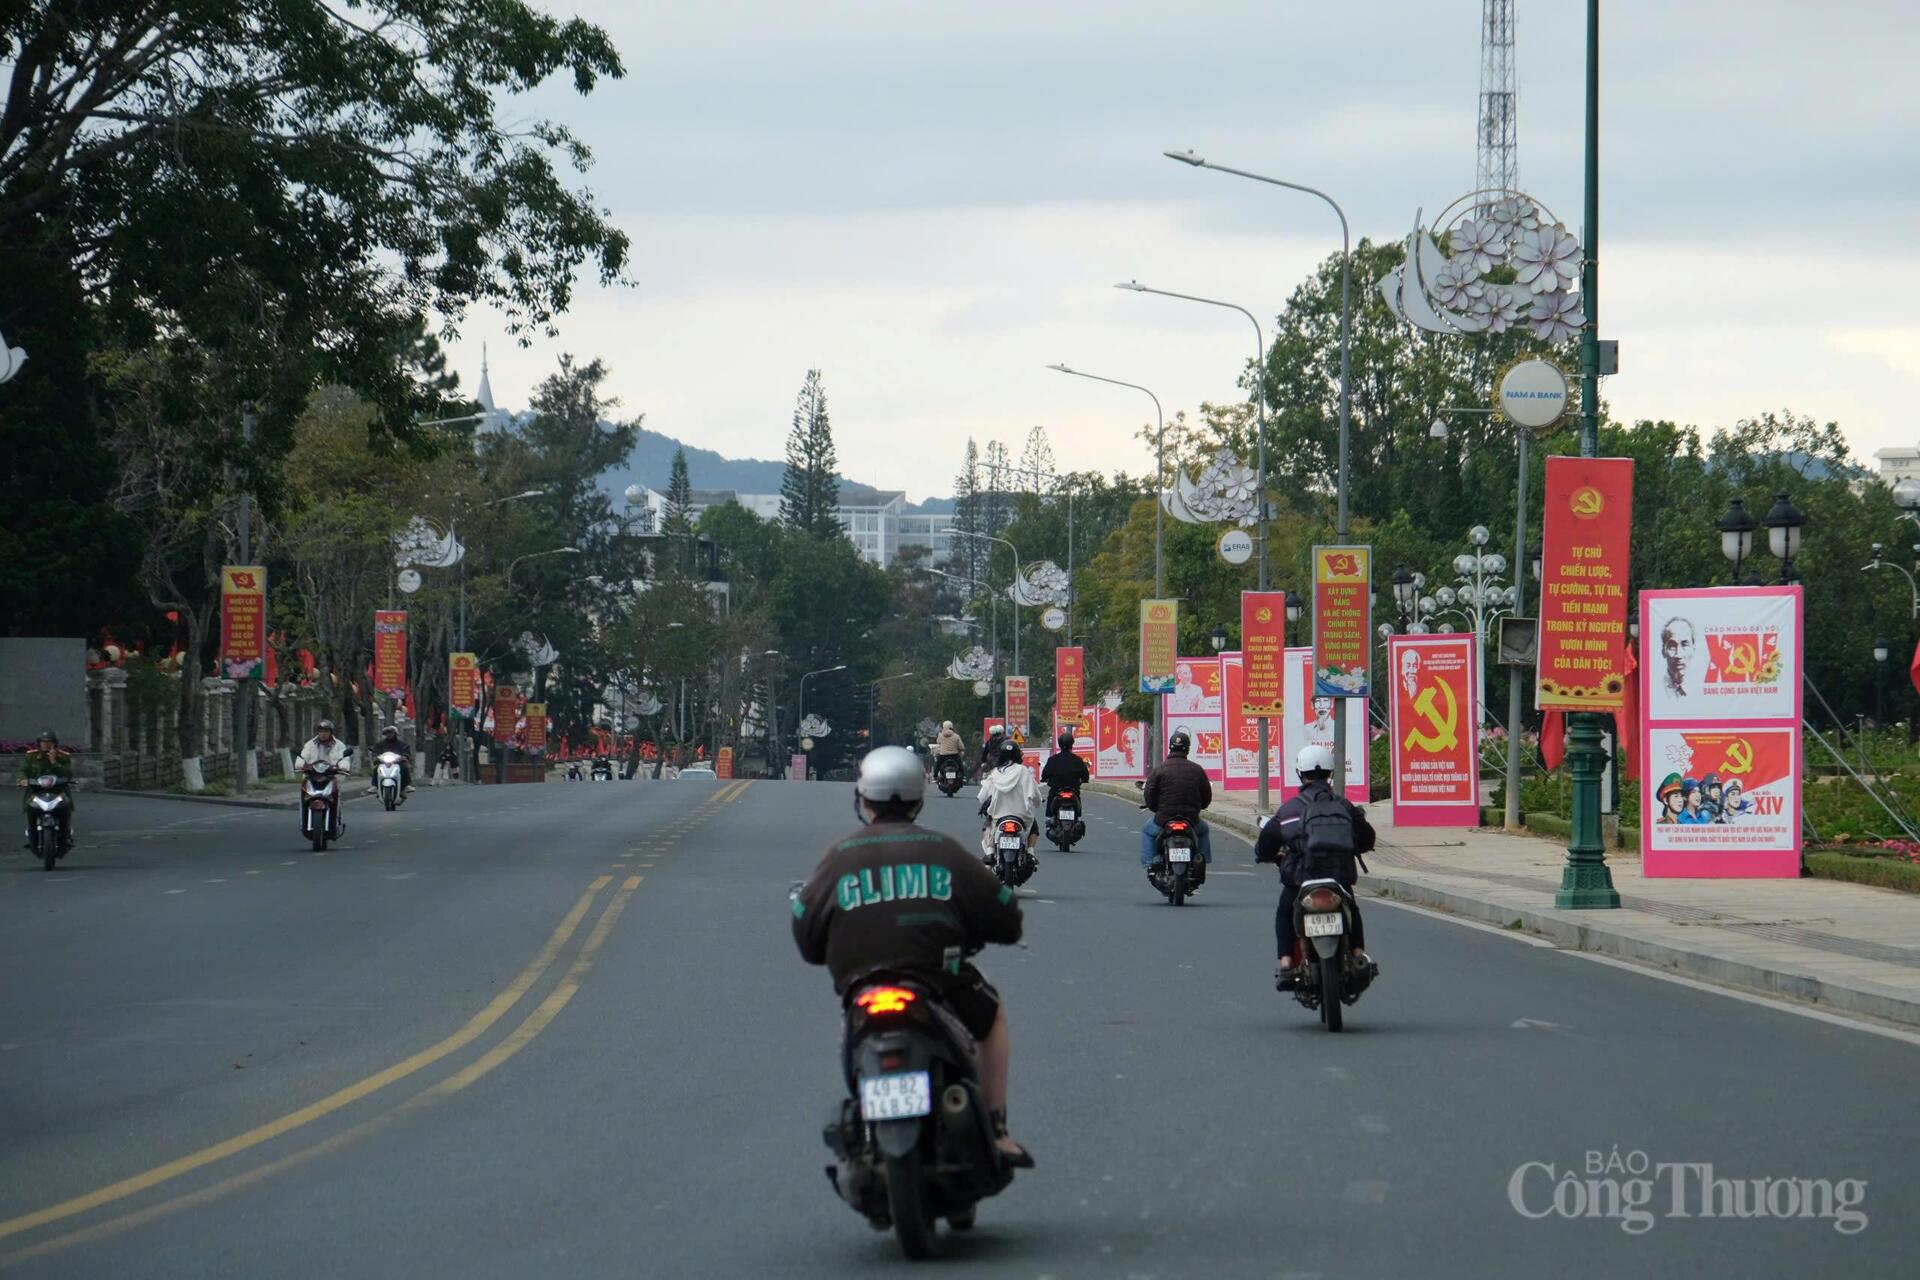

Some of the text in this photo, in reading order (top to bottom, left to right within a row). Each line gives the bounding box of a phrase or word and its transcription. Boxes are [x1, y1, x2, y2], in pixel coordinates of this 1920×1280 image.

[1537, 391, 1562, 399] BANK
[1572, 544, 1602, 560] TỰ CHỦ
[1560, 563, 1586, 576] CHIẾN
[1548, 583, 1560, 596] TỰ
[1594, 584, 1605, 598] TỰ
[1562, 600, 1608, 616] TIẾN MẠNH
[1547, 618, 1622, 633] TRONG KỶ NGUYÊN
[1560, 638, 1608, 652] VƯƠN MÌNH
[1554, 654, 1612, 672] CỦA DÂN TỘC!
[1754, 796, 1784, 815] XIV
